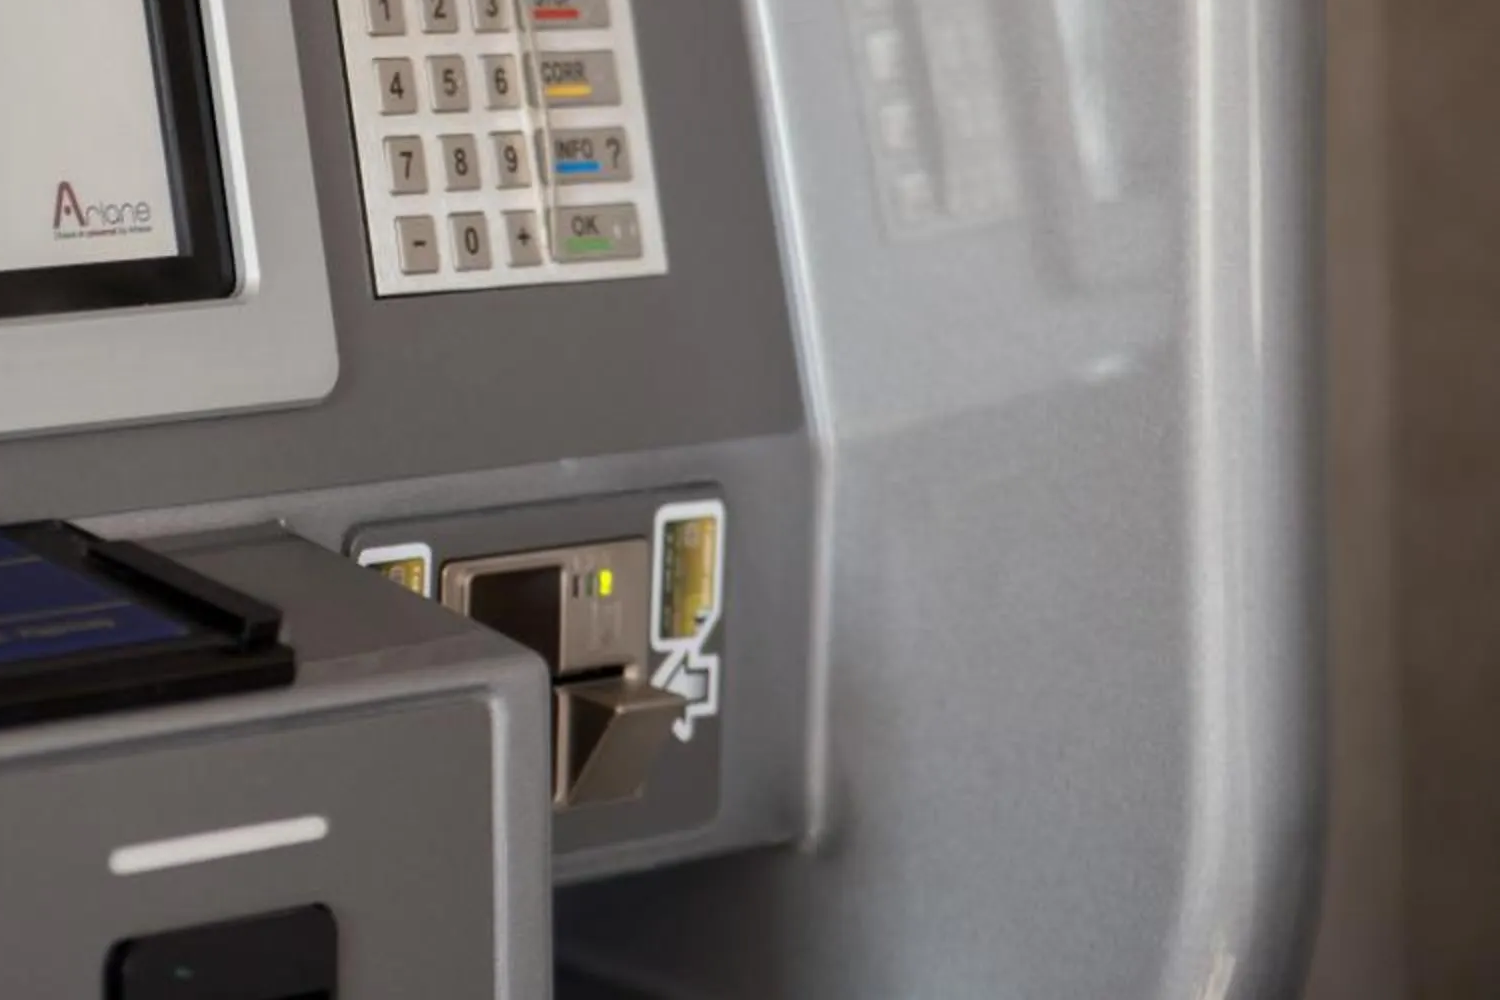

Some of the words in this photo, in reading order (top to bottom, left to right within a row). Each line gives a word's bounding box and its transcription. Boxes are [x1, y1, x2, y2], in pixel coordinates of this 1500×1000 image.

[389, 71, 405, 100] 4
[442, 69, 459, 96] 5
[494, 68, 510, 95] 6
[399, 150, 414, 180] 7
[453, 148, 469, 176] 8
[503, 145, 519, 173] 9
[53, 180, 152, 230] Ariane
[571, 215, 600, 237] OK
[464, 226, 480, 256] 0
